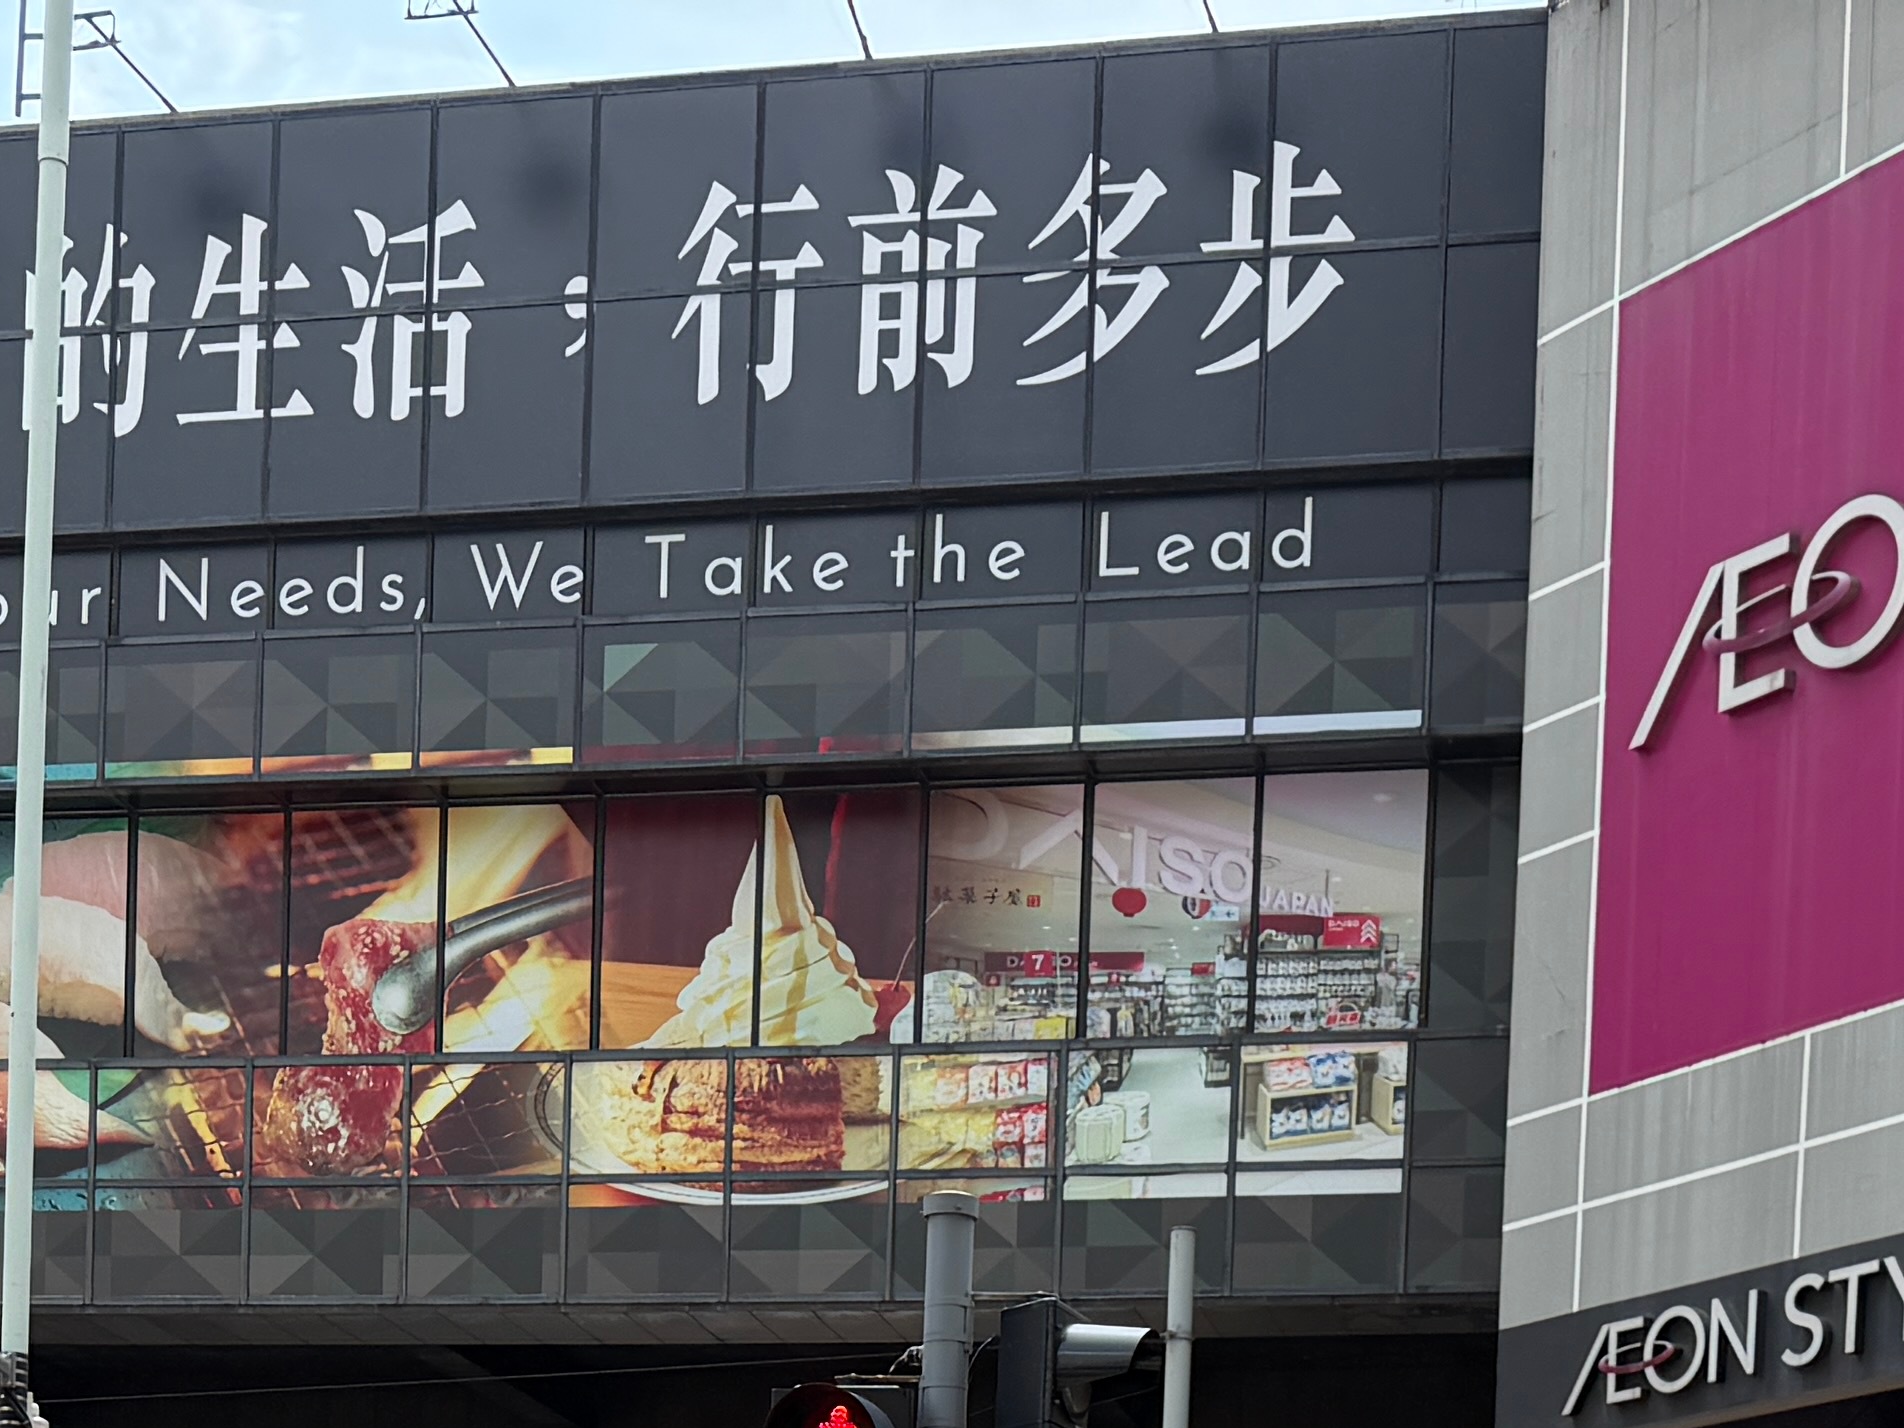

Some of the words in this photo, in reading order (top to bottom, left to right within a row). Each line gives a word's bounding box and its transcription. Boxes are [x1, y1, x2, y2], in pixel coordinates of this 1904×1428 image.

[156, 547, 427, 624] Needs,
[468, 540, 586, 610] We
[644, 528, 851, 602] Take
[886, 514, 1028, 589] the
[1095, 497, 1318, 576] Lead
